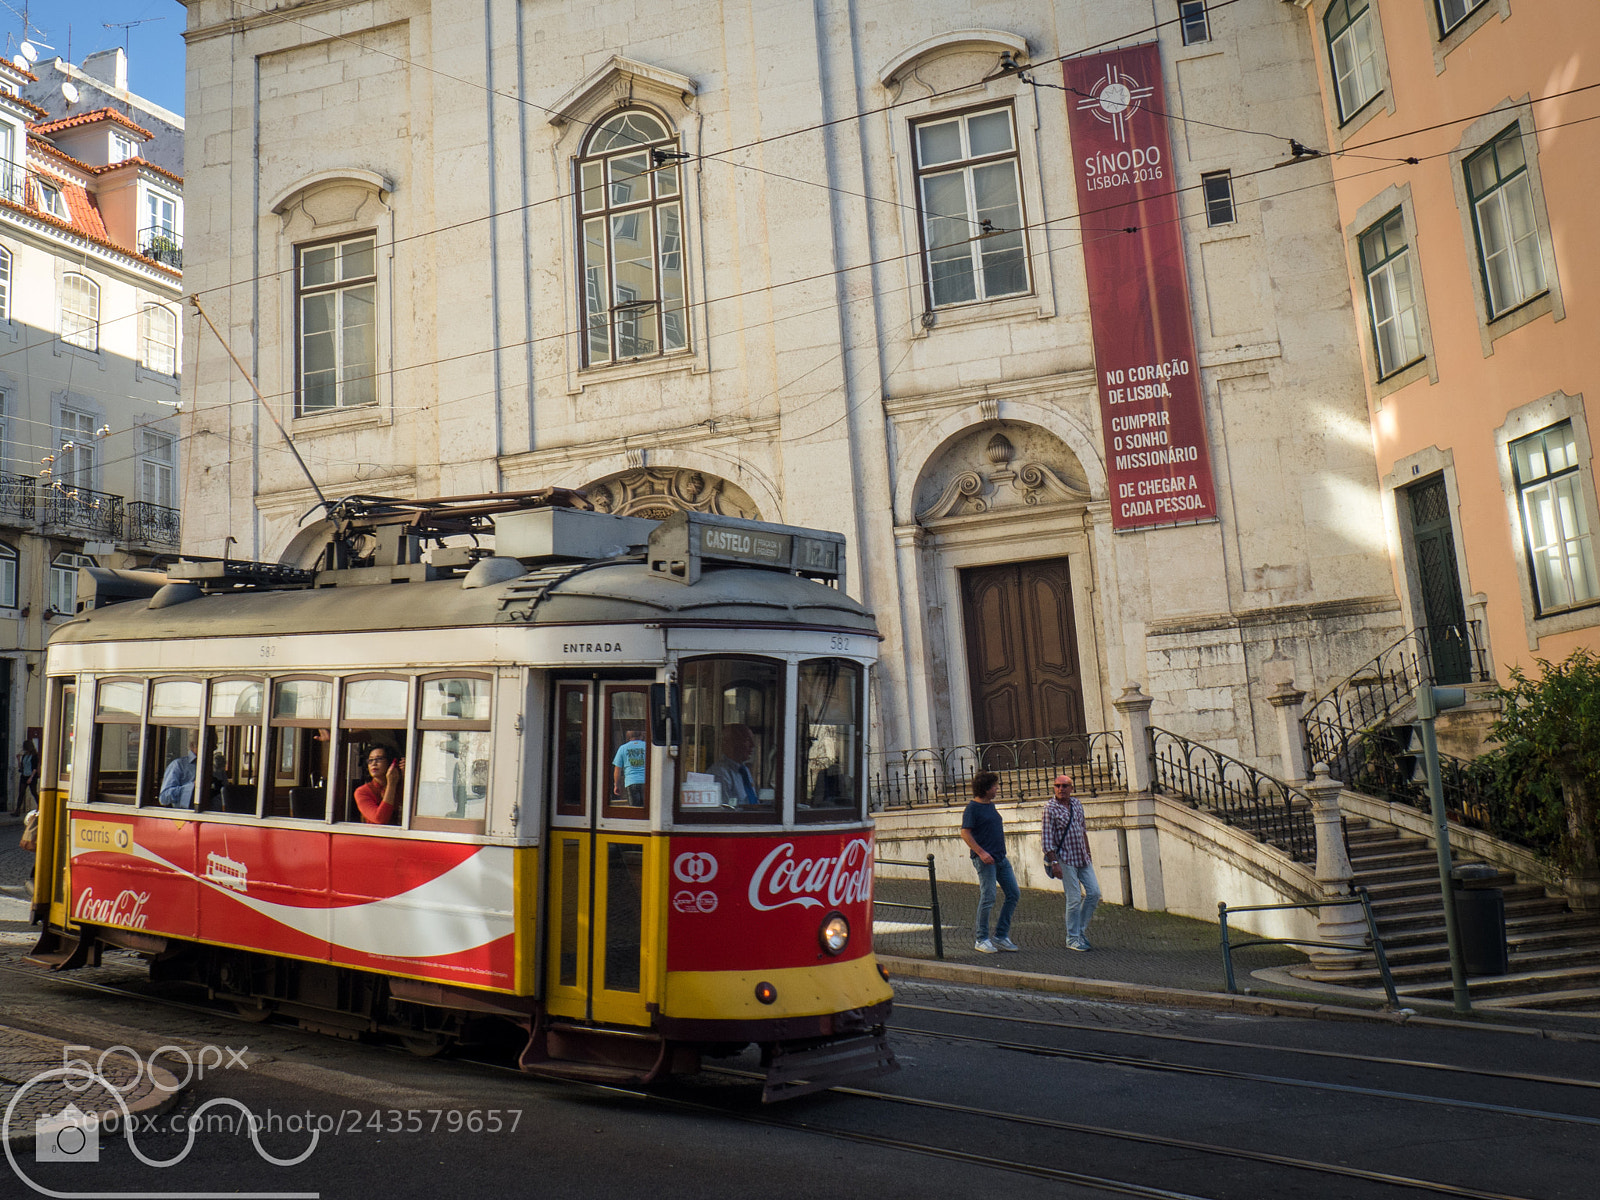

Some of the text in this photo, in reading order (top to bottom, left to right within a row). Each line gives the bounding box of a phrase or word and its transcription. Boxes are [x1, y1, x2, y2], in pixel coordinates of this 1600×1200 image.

[1085, 146, 1161, 177] SÍNODO
[1087, 166, 1163, 191] LISBOA 2016
[1106, 359, 1189, 386] NO CORAÇÃO
[1108, 383, 1172, 405] DE LISBOA,
[1111, 411, 1170, 432] CUMPRIR
[1113, 430, 1168, 451] O SONHO
[1115, 446, 1198, 471] MISSIONÁRIO
[1118, 474, 1198, 499] DE CHEGAR A
[1121, 494, 1206, 518] CADA PESSOA.
[706, 530, 750, 553] CASTELO
[260, 645, 276, 658] 582
[563, 642, 622, 653] ENTRADA
[830, 636, 849, 651] 582
[81, 826, 110, 844] carris
